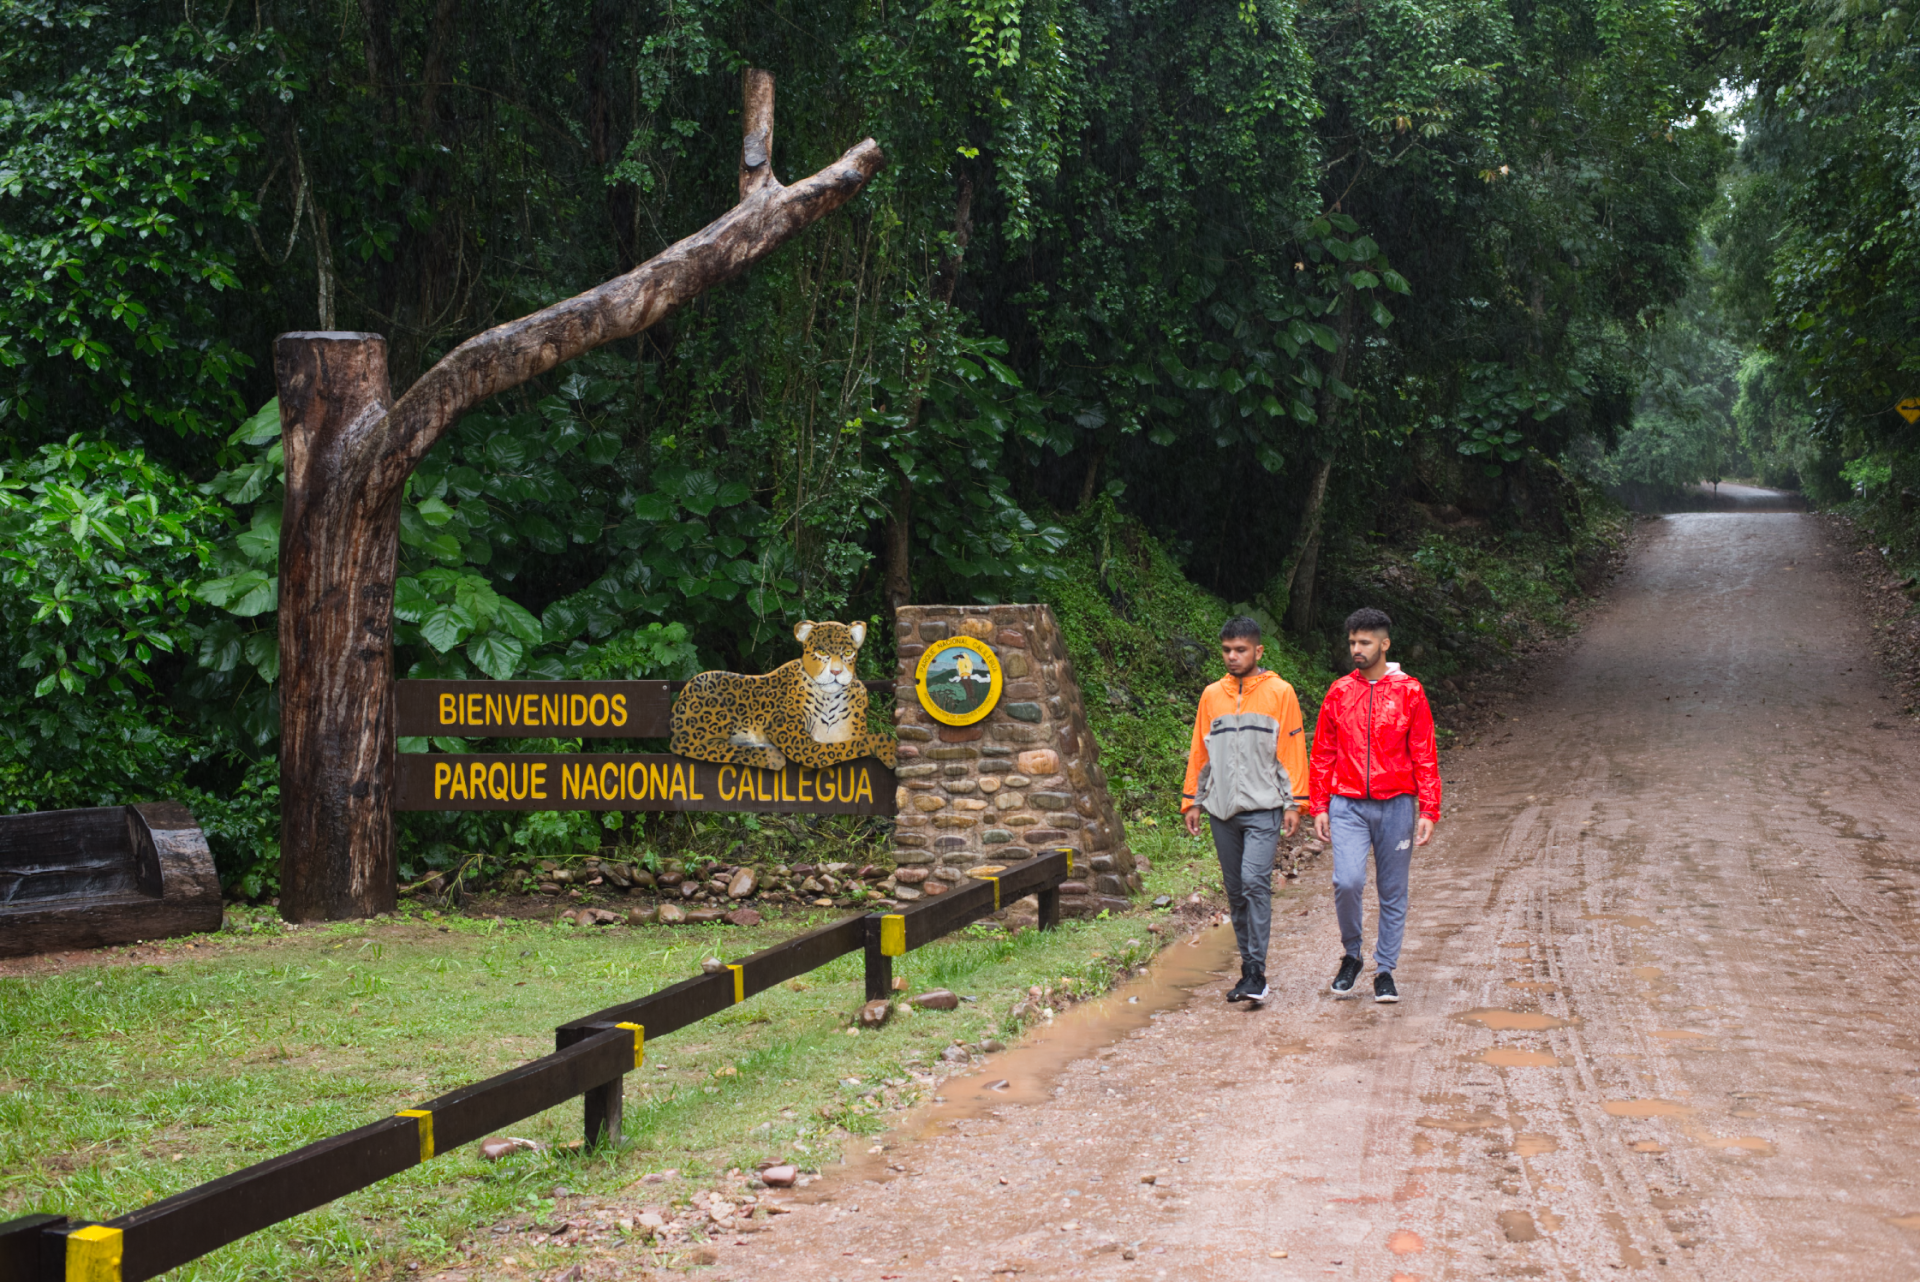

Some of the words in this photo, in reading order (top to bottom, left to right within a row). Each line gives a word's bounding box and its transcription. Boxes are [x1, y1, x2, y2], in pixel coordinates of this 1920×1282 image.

[936, 637, 969, 649] NACIONAL
[440, 692, 628, 727] BIENVENIDOS
[434, 762, 548, 802] PARQUE
[562, 761, 705, 801] NACIONAL
[717, 764, 874, 804] CALILEGUA
